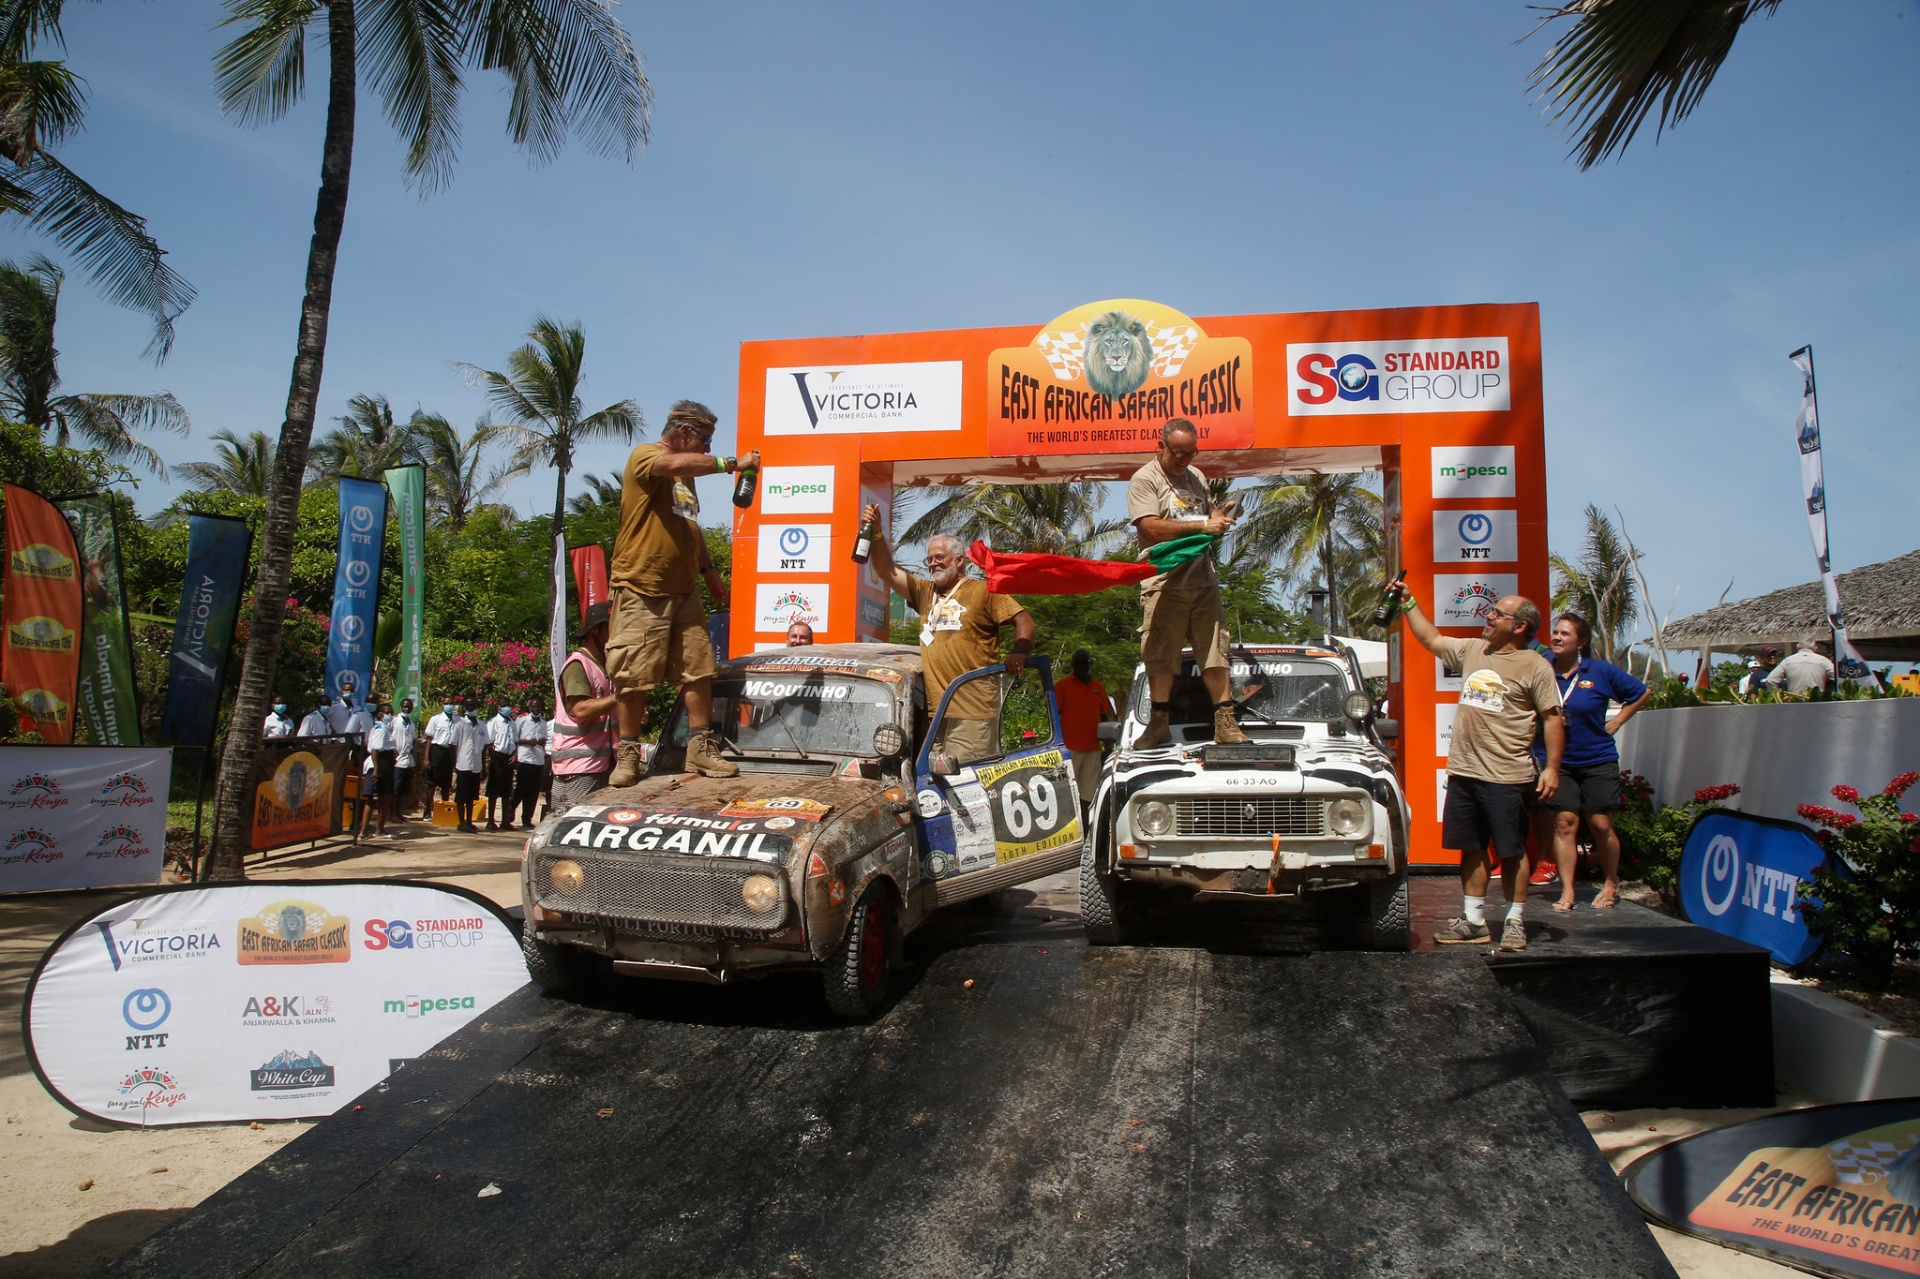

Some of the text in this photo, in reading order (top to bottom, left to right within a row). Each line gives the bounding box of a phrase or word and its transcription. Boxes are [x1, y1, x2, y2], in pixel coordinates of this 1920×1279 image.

[1384, 350, 1500, 373] STANDARD
[1001, 355, 1242, 425] EAST AFRICAN SAFARI CLASSIC
[1385, 373, 1501, 401] GROUP
[815, 391, 918, 411] VICTORIA
[828, 411, 878, 420] COMMERCIAL
[1027, 428, 1163, 444] THE WORLD'S GREATEST CLAS
[1460, 547, 1491, 559] NTT
[780, 559, 806, 569] NTT
[788, 610, 819, 624] Kenya
[30, 793, 70, 809] Kenya
[120, 792, 154, 807] Kenya
[769, 800, 800, 808] 69
[1001, 774, 1058, 839] 69
[560, 821, 774, 862] ARGANIL
[1002, 846, 1027, 861] 10TH
[1036, 832, 1074, 851] EDITION
[25, 848, 65, 863] Kenya
[115, 844, 149, 859] Kenya
[1741, 862, 1801, 924] NTT
[416, 918, 483, 932] STANDARD
[570, 912, 642, 932] RENAULT
[119, 932, 221, 955] VICTORIA
[242, 924, 347, 953] EAST AFRICAN SAFARI CLASSIC
[416, 931, 484, 949] GROUP
[131, 953, 183, 963] COMMERCIAL
[242, 996, 300, 1017] A&K
[242, 1019, 294, 1027] ANJARWALLA
[303, 1017, 336, 1025] KHANNA
[126, 1033, 169, 1050] NTT
[257, 1068, 326, 1087] White Cap
[144, 1090, 188, 1109] Kenya
[1725, 1161, 1920, 1236] EAST AFRICAN
[1752, 1217, 1783, 1231] THE
[1784, 1225, 1858, 1248] WORLD'S
